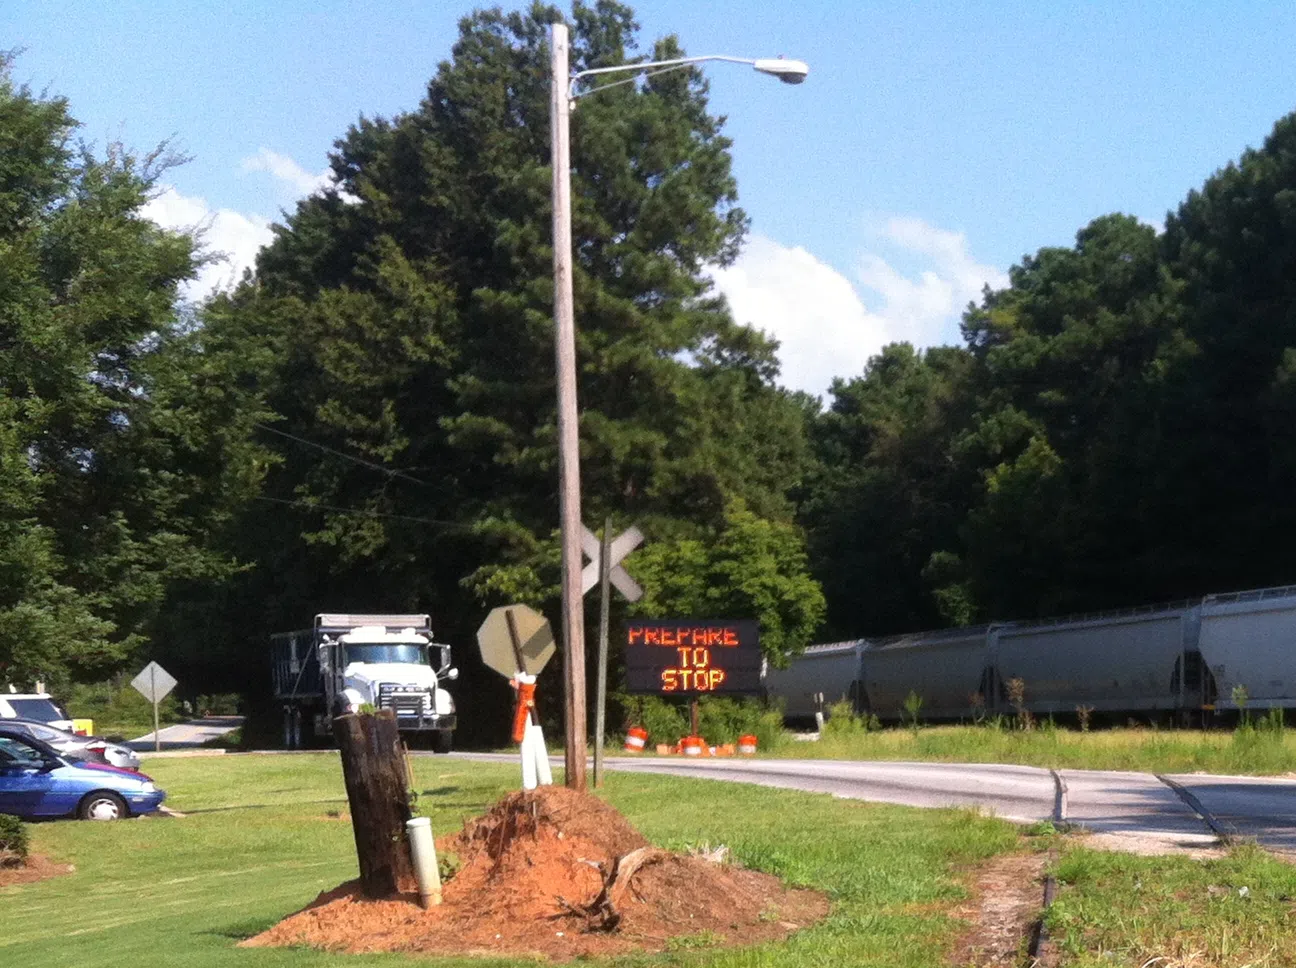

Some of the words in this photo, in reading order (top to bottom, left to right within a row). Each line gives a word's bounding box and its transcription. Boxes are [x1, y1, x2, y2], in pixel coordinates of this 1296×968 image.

[628, 627, 740, 646] PREPARE
[677, 646, 710, 668] TO
[661, 668, 726, 691] STOP
